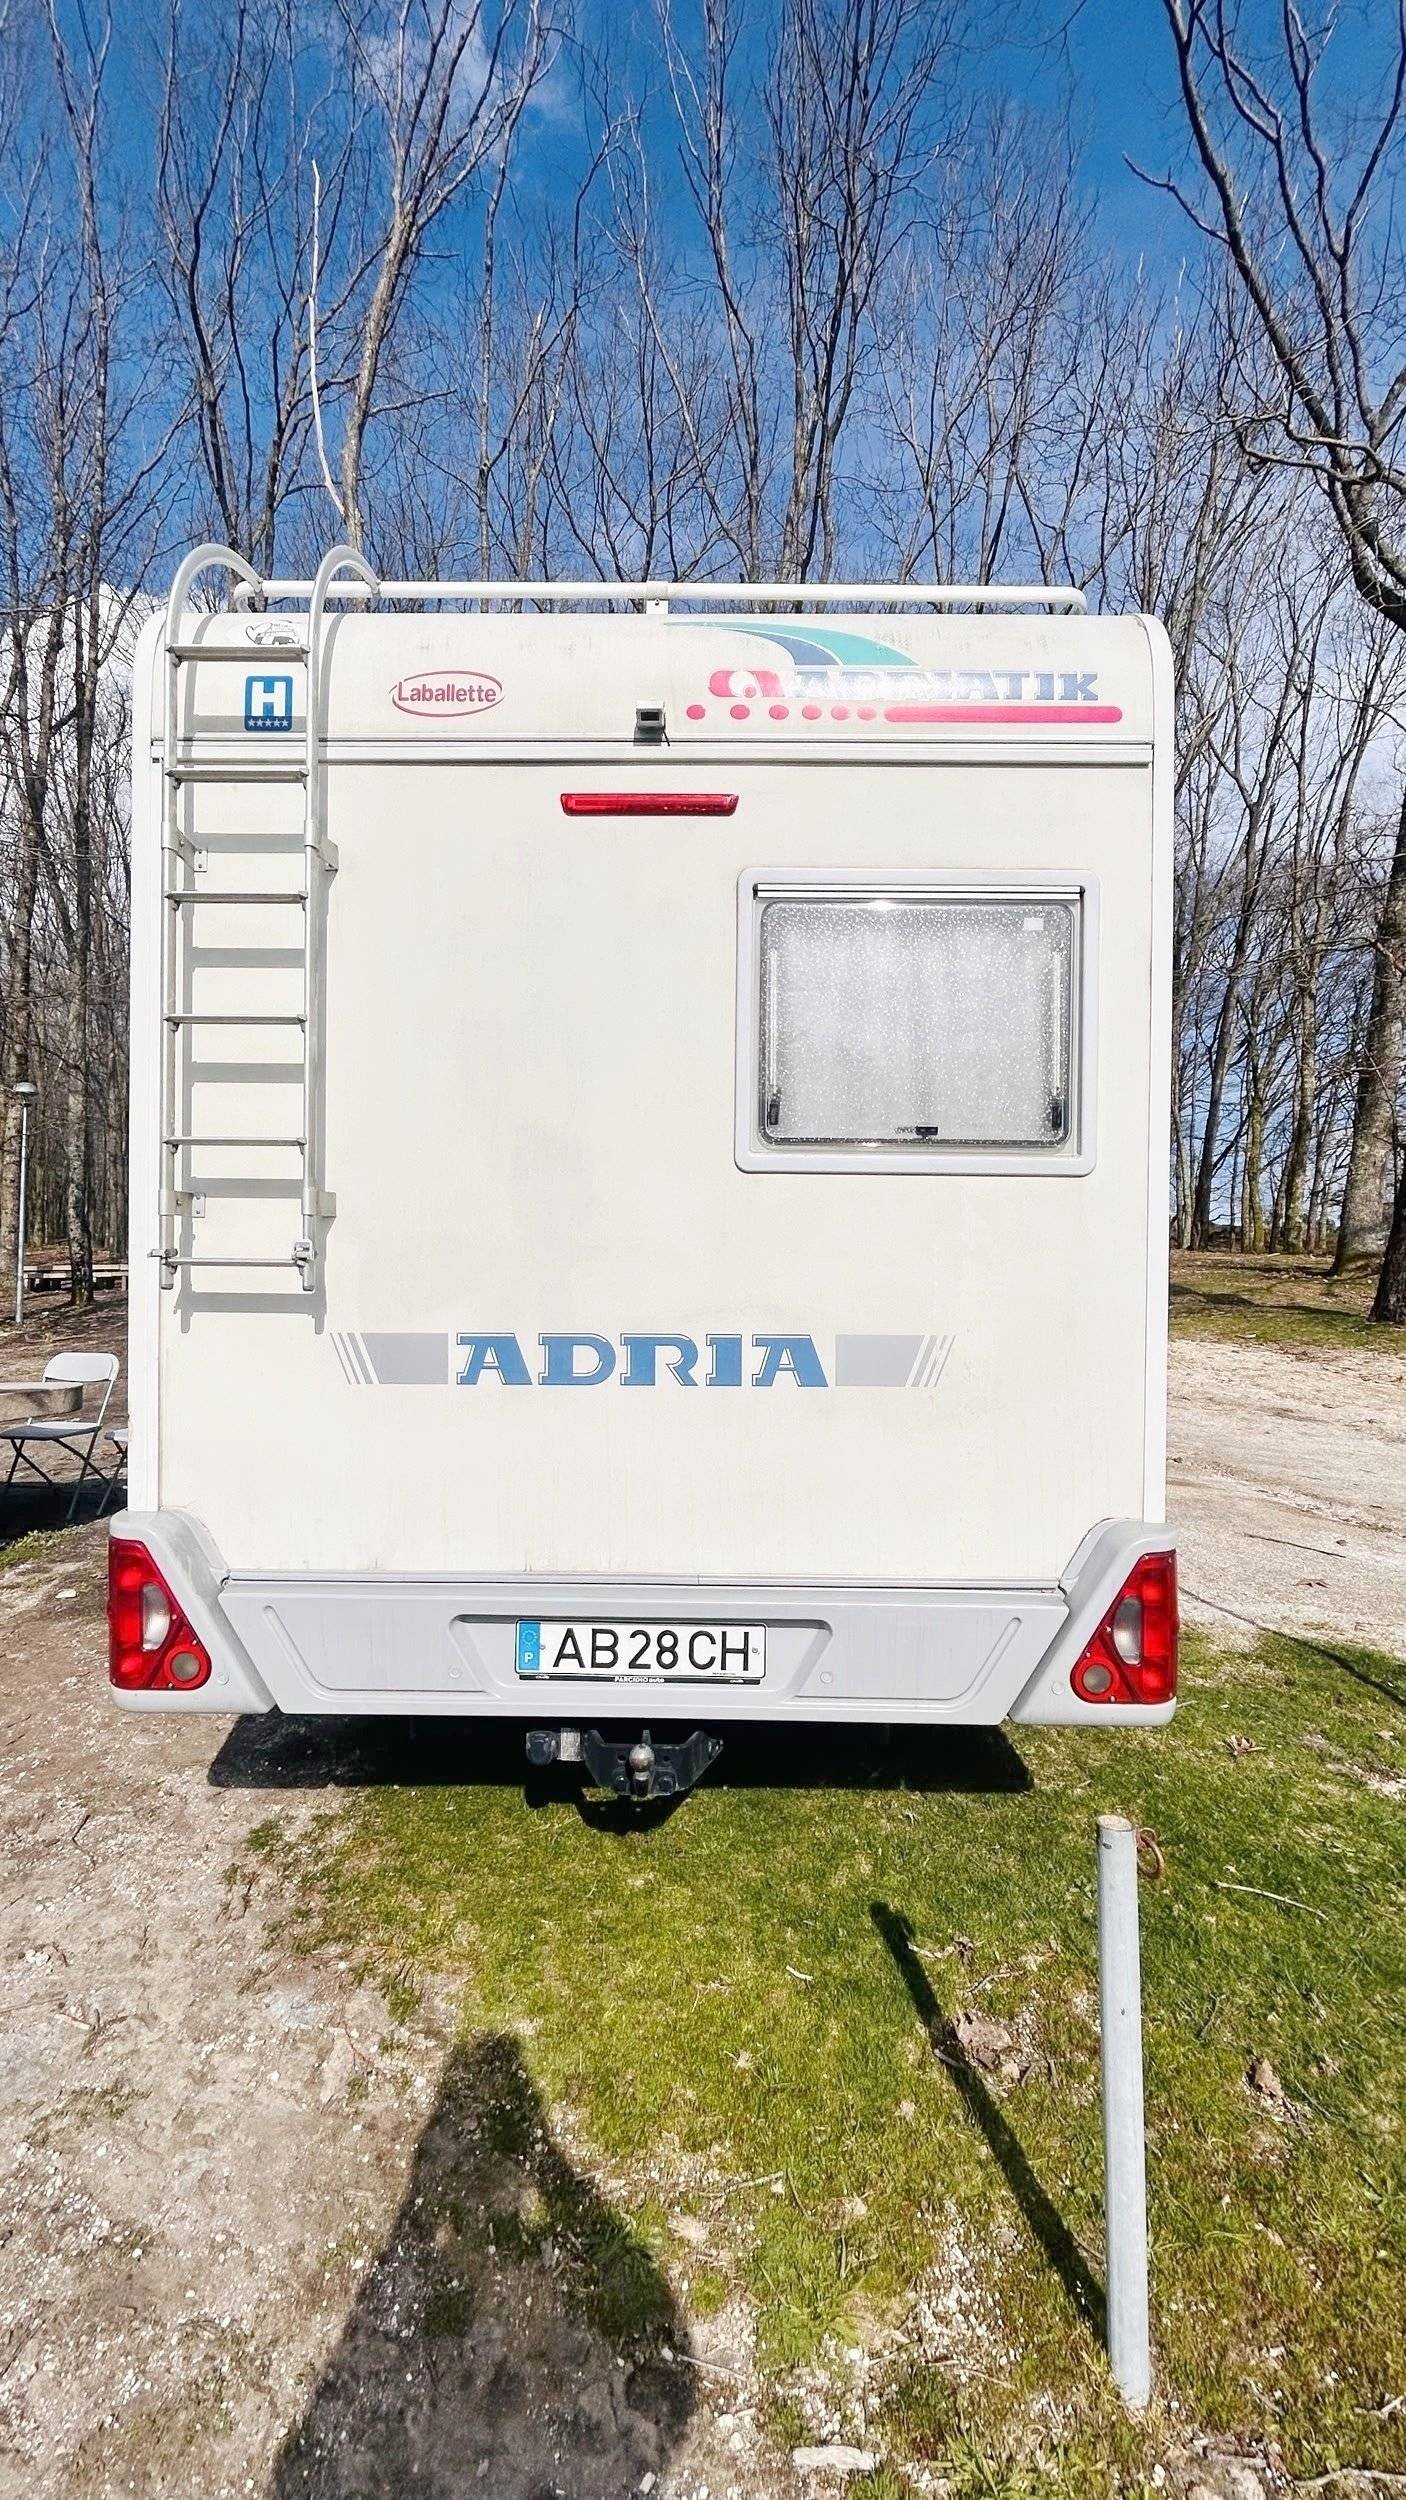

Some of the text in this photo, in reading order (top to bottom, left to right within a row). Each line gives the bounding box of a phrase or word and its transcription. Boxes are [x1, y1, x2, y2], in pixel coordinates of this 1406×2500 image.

[251, 681, 287, 717] H
[397, 681, 497, 702] Laballette
[456, 1332, 829, 1387] ADRIA
[523, 1650, 535, 1663] P
